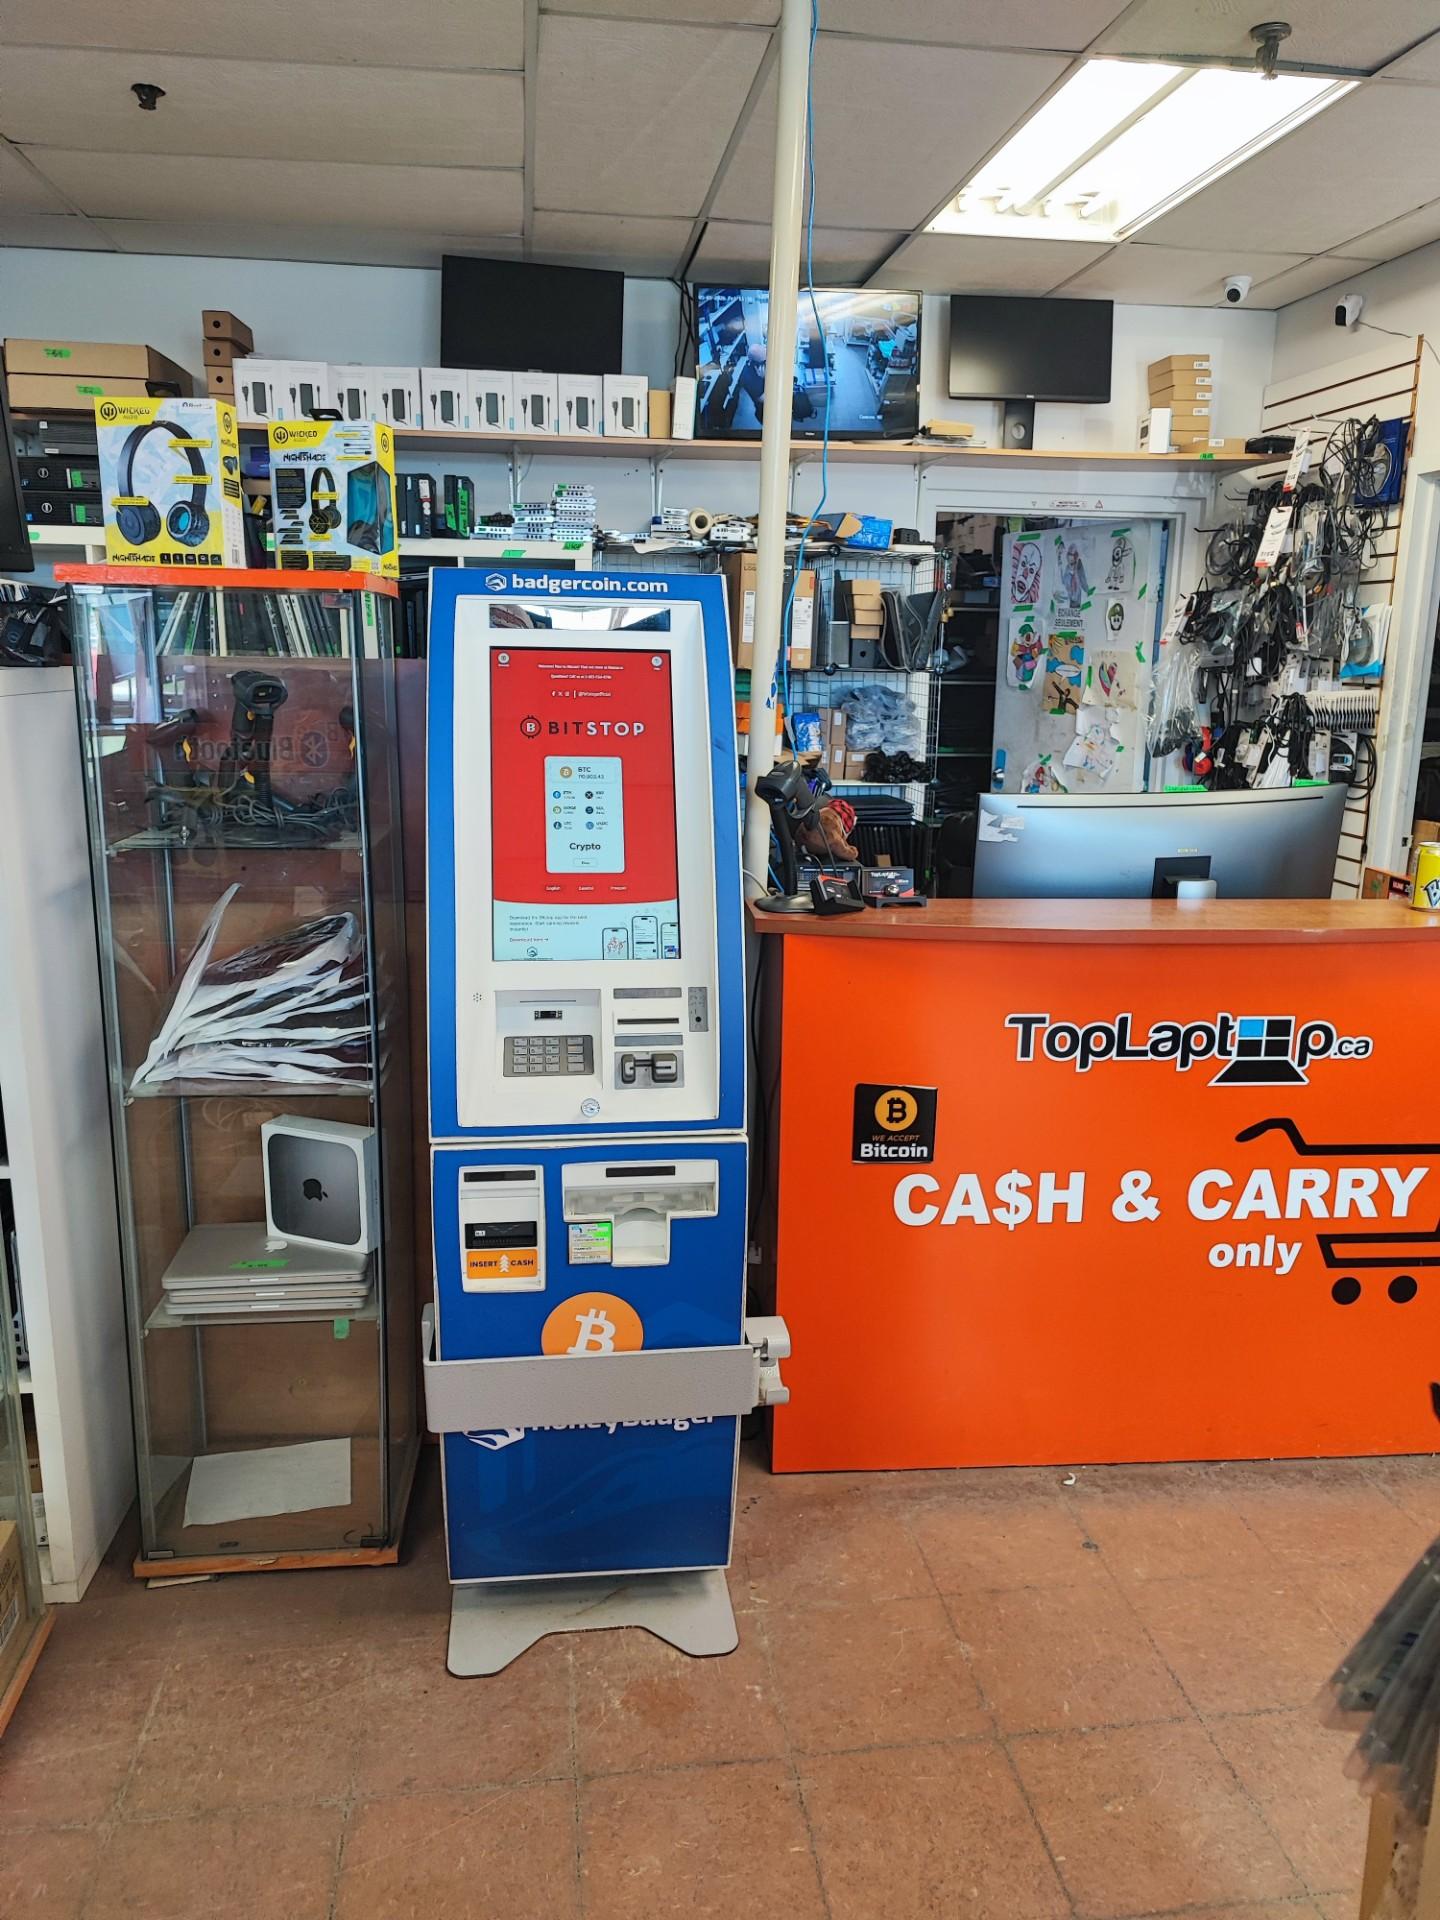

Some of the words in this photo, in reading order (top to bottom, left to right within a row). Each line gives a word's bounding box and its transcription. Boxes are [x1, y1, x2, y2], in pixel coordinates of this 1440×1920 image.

[117, 407, 150, 415] WICKED
[289, 430, 318, 438] WICKED
[511, 573, 669, 595] badgercoin.com
[548, 721, 646, 737] BITSTOP
[569, 842, 602, 852] Crypto
[860, 1142, 928, 1158] Bitcoin
[892, 1168, 1086, 1230] CA$H
[1111, 1169, 1160, 1223] &
[1187, 1166, 1431, 1221] CARRY
[1208, 1234, 1302, 1275] only
[469, 1259, 498, 1267] INSERT
[510, 1259, 534, 1267] CASH
